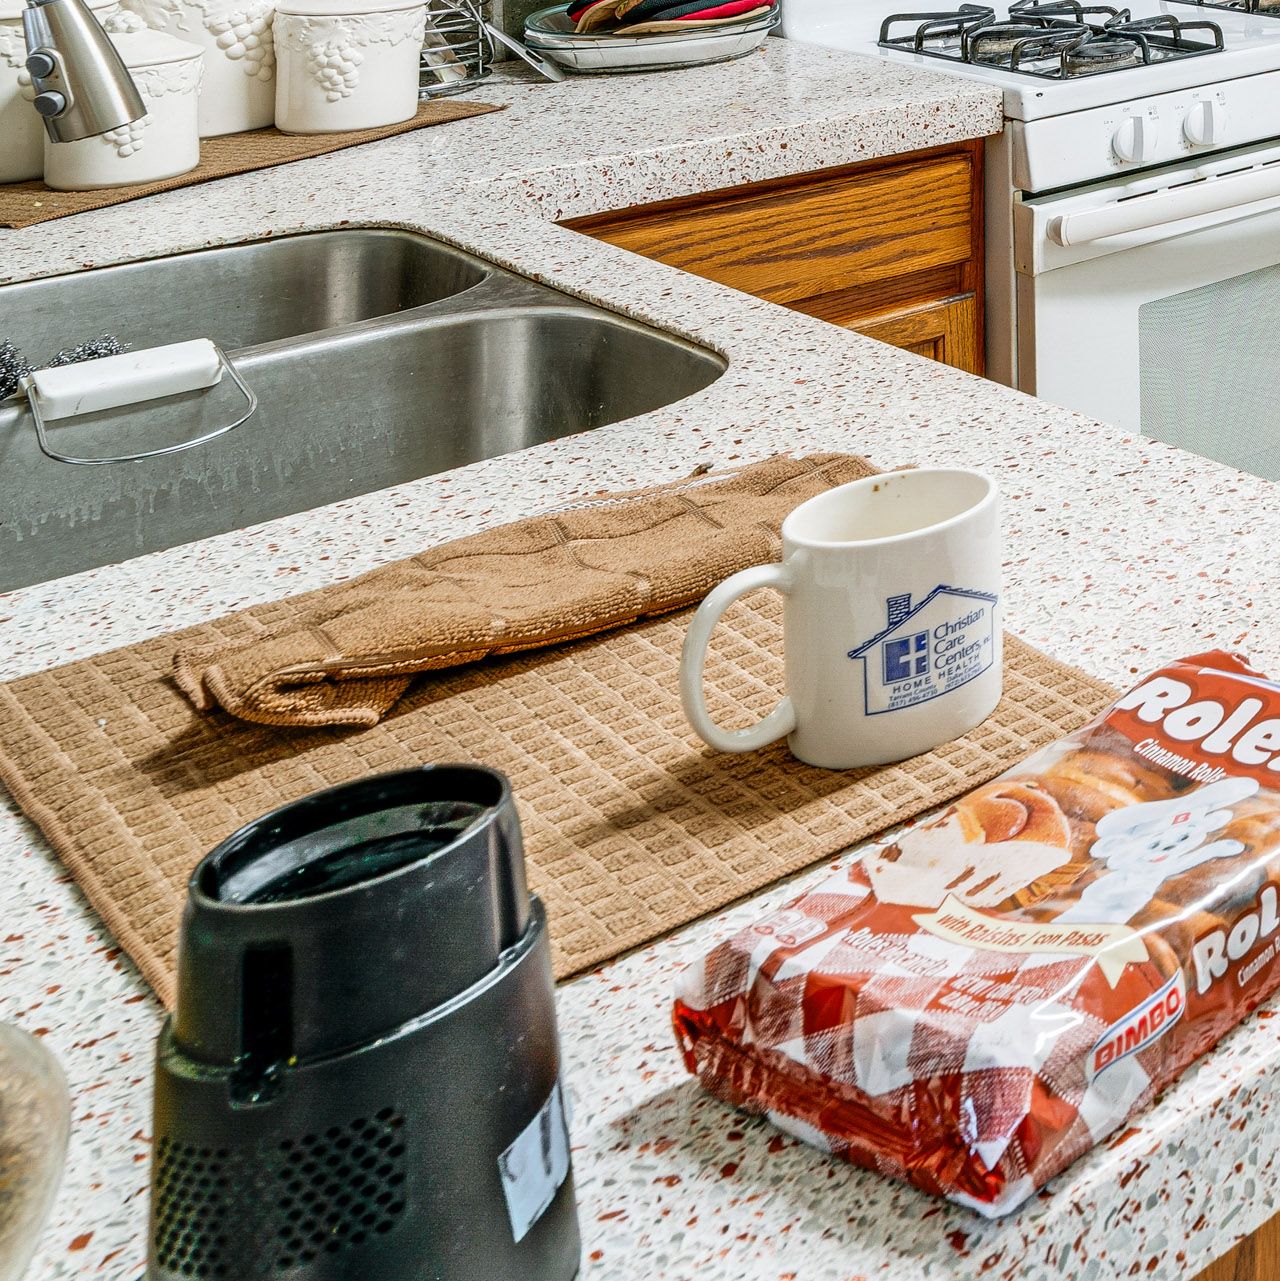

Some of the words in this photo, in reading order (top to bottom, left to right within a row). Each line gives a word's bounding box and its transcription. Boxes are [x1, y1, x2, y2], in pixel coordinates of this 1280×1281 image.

[934, 607, 984, 640] Christian
[934, 634, 965, 655] Care
[893, 676, 932, 695] HOME
[938, 654, 980, 680] HEALTH
[1133, 738, 1196, 776] Cinnamon
[1188, 762, 1227, 783] Rolls
[962, 923, 1028, 947] Raisins
[1033, 933, 1061, 945] con
[1060, 931, 1110, 947] Pasas
[1238, 943, 1275, 988] Cinnamon
[1093, 986, 1181, 1073] BIMBO
